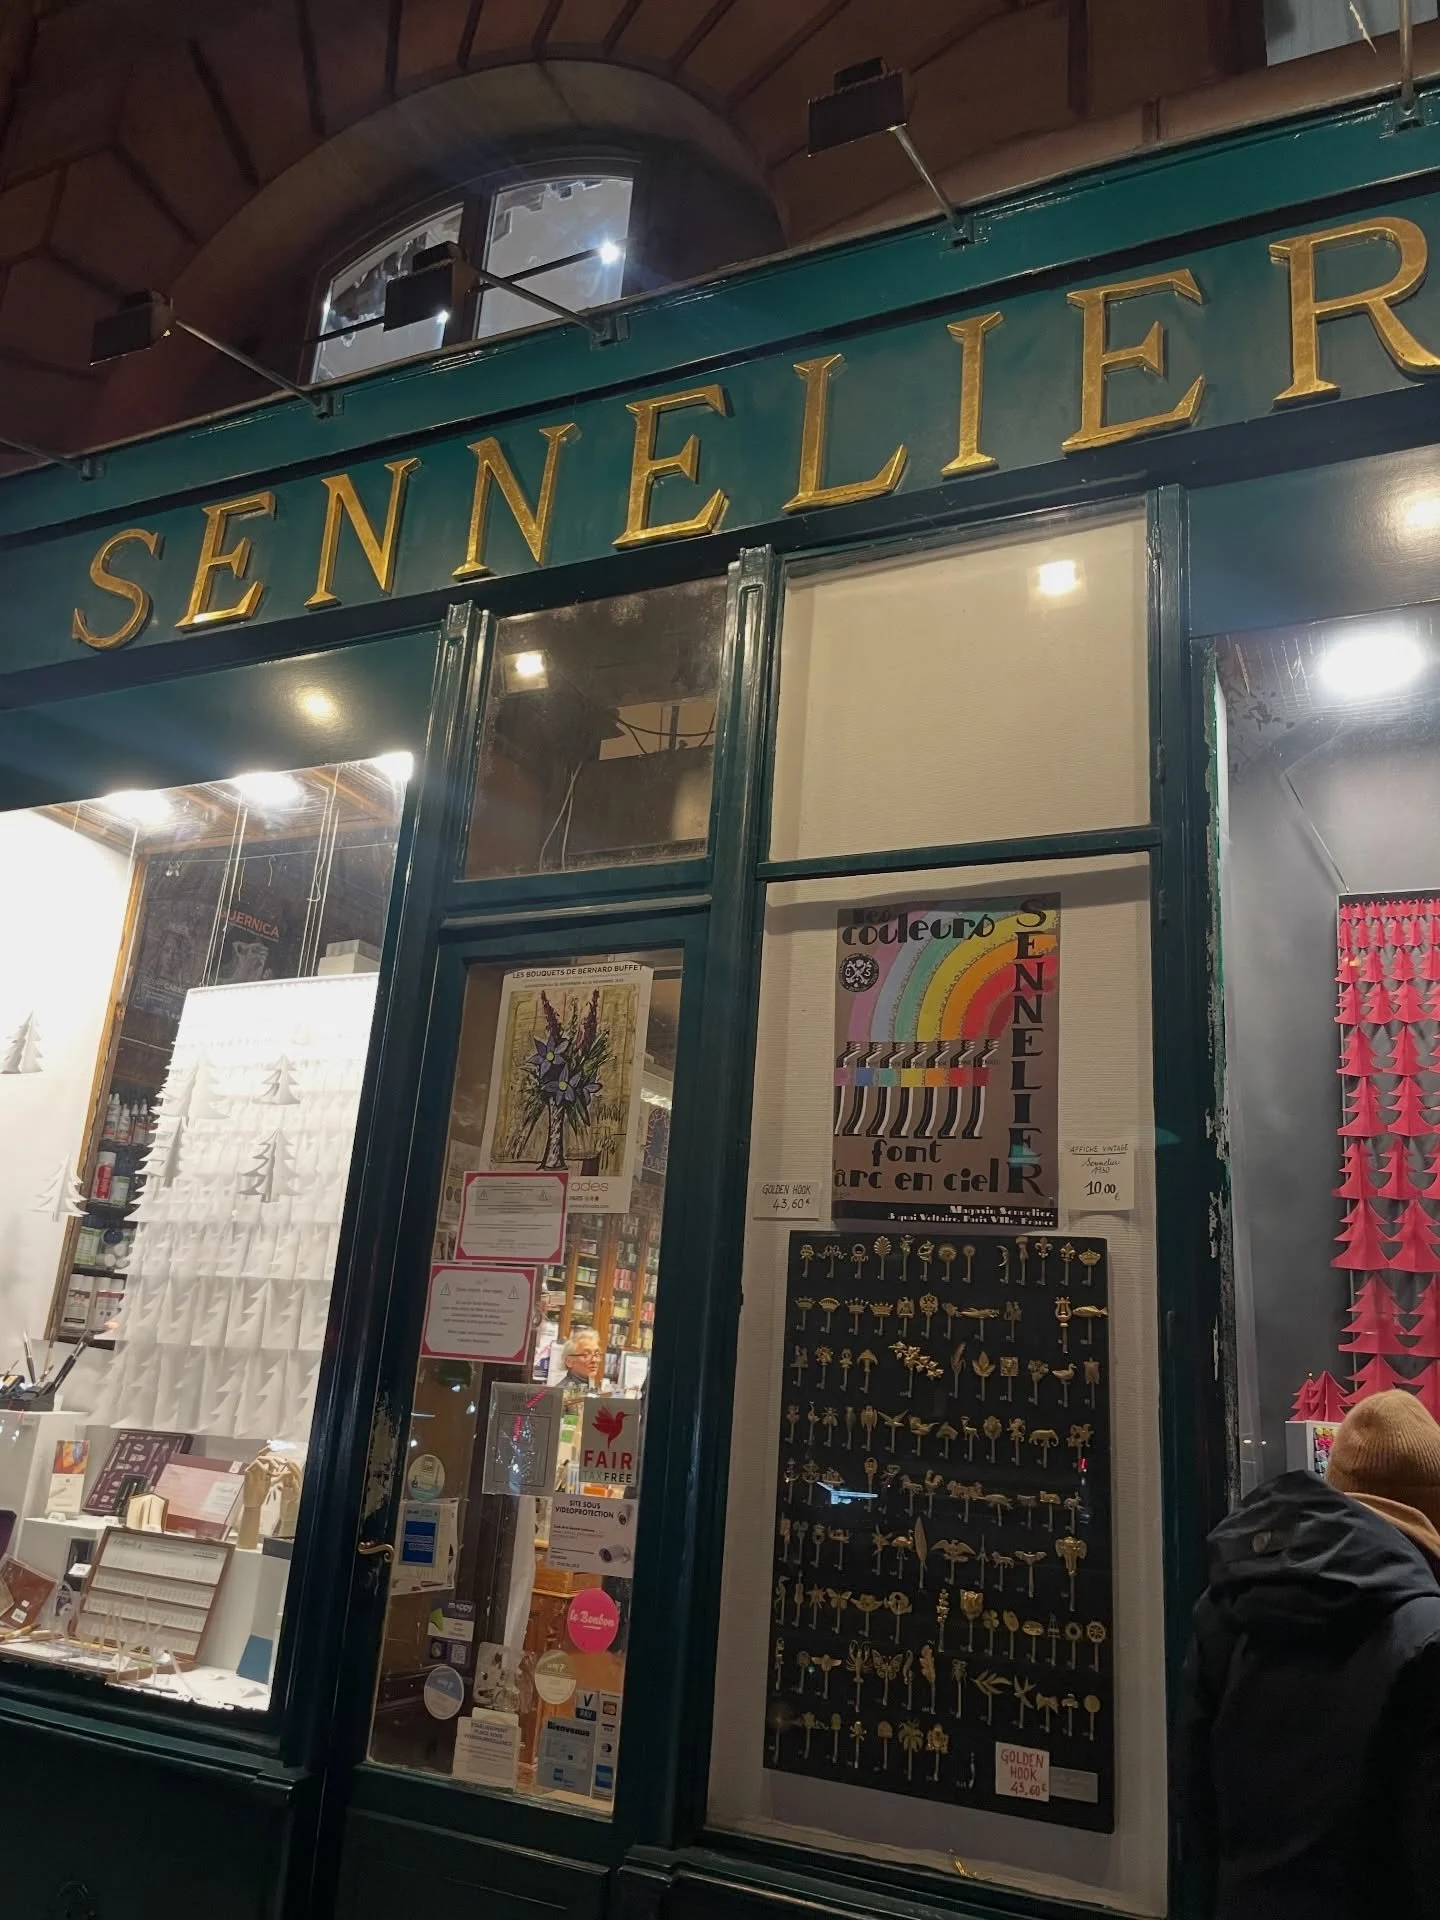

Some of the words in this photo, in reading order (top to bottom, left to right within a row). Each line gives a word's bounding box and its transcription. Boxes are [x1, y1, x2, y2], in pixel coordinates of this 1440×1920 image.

[71, 214, 1440, 651] SENNELIER
[842, 912, 995, 946] couleurs
[512, 971, 525, 979] LES
[526, 968, 565, 978] BOUQUETS
[566, 968, 576, 976] DE
[578, 966, 612, 975] BERNARD
[614, 964, 643, 972] BUFFET
[1007, 899, 1047, 1197] SENNELIER
[872, 1138, 942, 1167] font
[895, 1172, 932, 1192] en
[943, 1158, 999, 1193] ciel
[762, 1184, 790, 1195] GOLDEN
[792, 1184, 811, 1195] HOOK
[949, 1205, 996, 1215] Magasin
[583, 1449, 634, 1471] FAIR
[583, 1501, 601, 1509] SOUS
[1000, 1748, 1044, 1768] GOLDEN
[1010, 1765, 1037, 1781] HOOK
